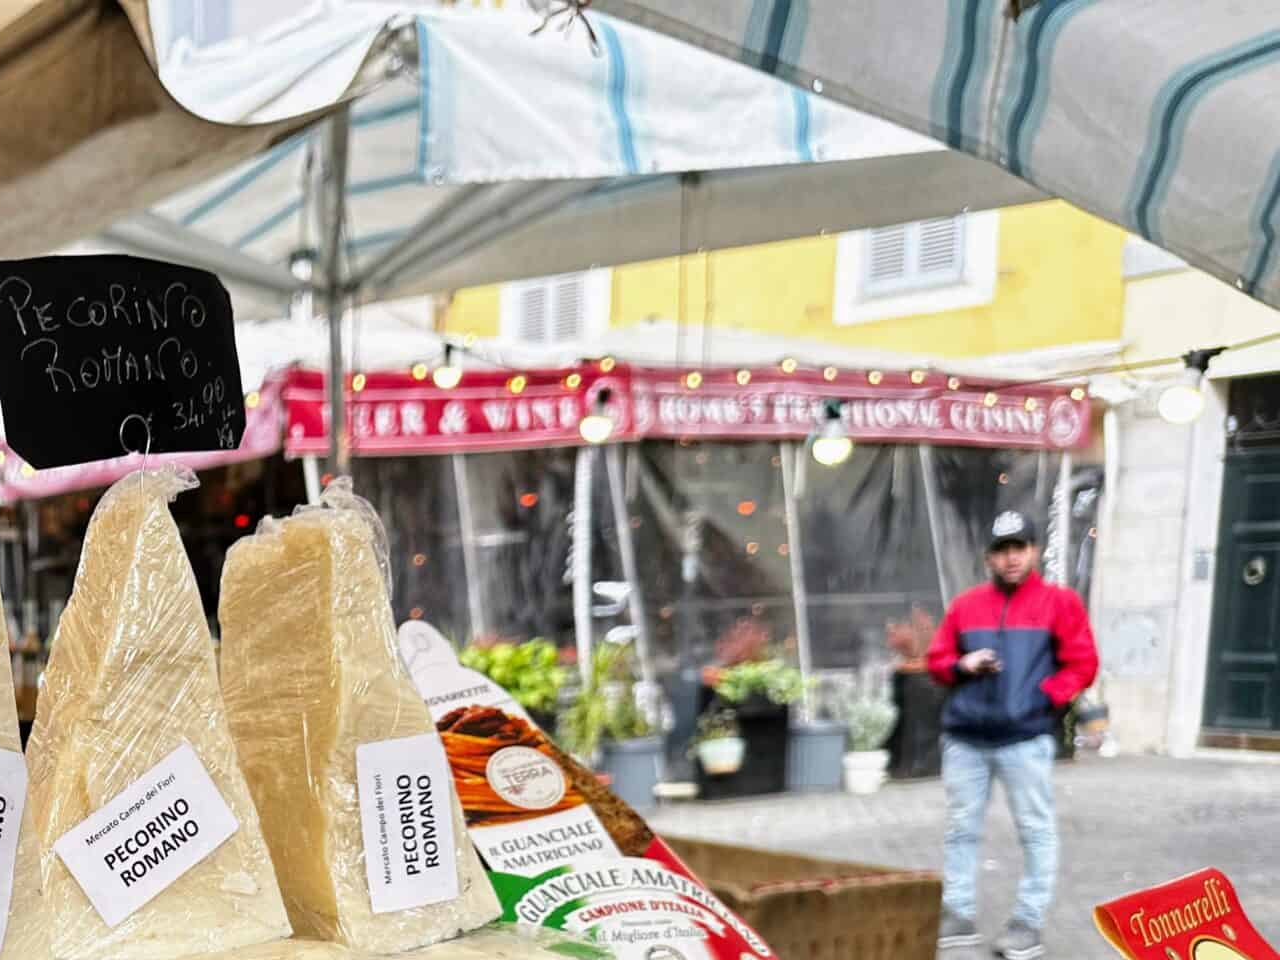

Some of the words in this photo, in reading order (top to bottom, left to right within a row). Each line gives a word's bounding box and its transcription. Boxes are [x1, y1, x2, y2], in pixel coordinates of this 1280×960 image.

[85, 820, 119, 846] Mercato
[119, 798, 145, 821] Campo
[145, 788, 158, 801] dei
[157, 773, 176, 790] Fiori
[103, 798, 189, 870] PECORINO
[396, 775, 421, 876] PECORINO
[417, 775, 440, 868] ROMANO
[502, 819, 597, 853] GUANCIALE
[120, 819, 199, 888] ROMANO
[503, 838, 603, 870] AMATRICIANO
[520, 868, 625, 924] GUANCIALE
[578, 900, 647, 922] CAMPIONE
[1129, 877, 1231, 947] Tonnarelli
